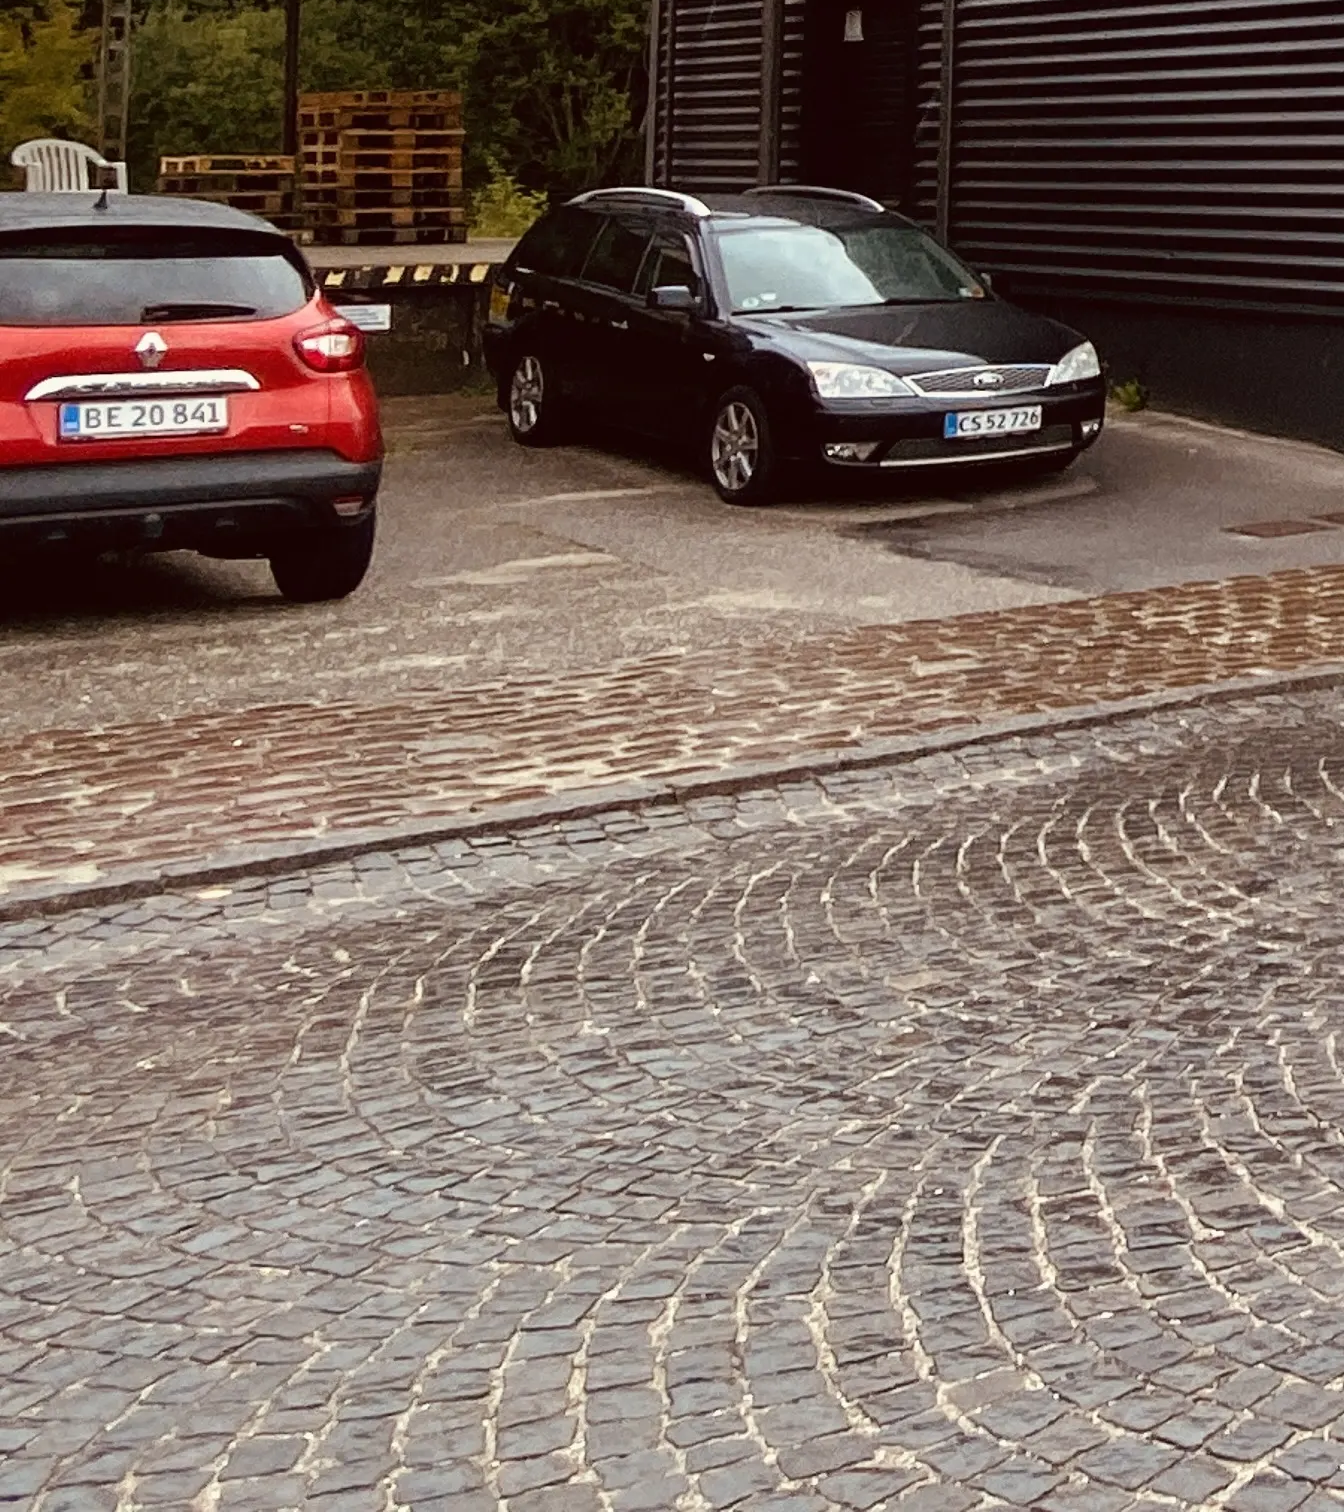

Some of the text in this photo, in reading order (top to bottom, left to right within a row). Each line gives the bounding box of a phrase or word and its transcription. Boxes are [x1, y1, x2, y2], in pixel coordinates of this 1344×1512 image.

[84, 402, 220, 429] BE 20 841
[959, 411, 1039, 432] CS 52 726
